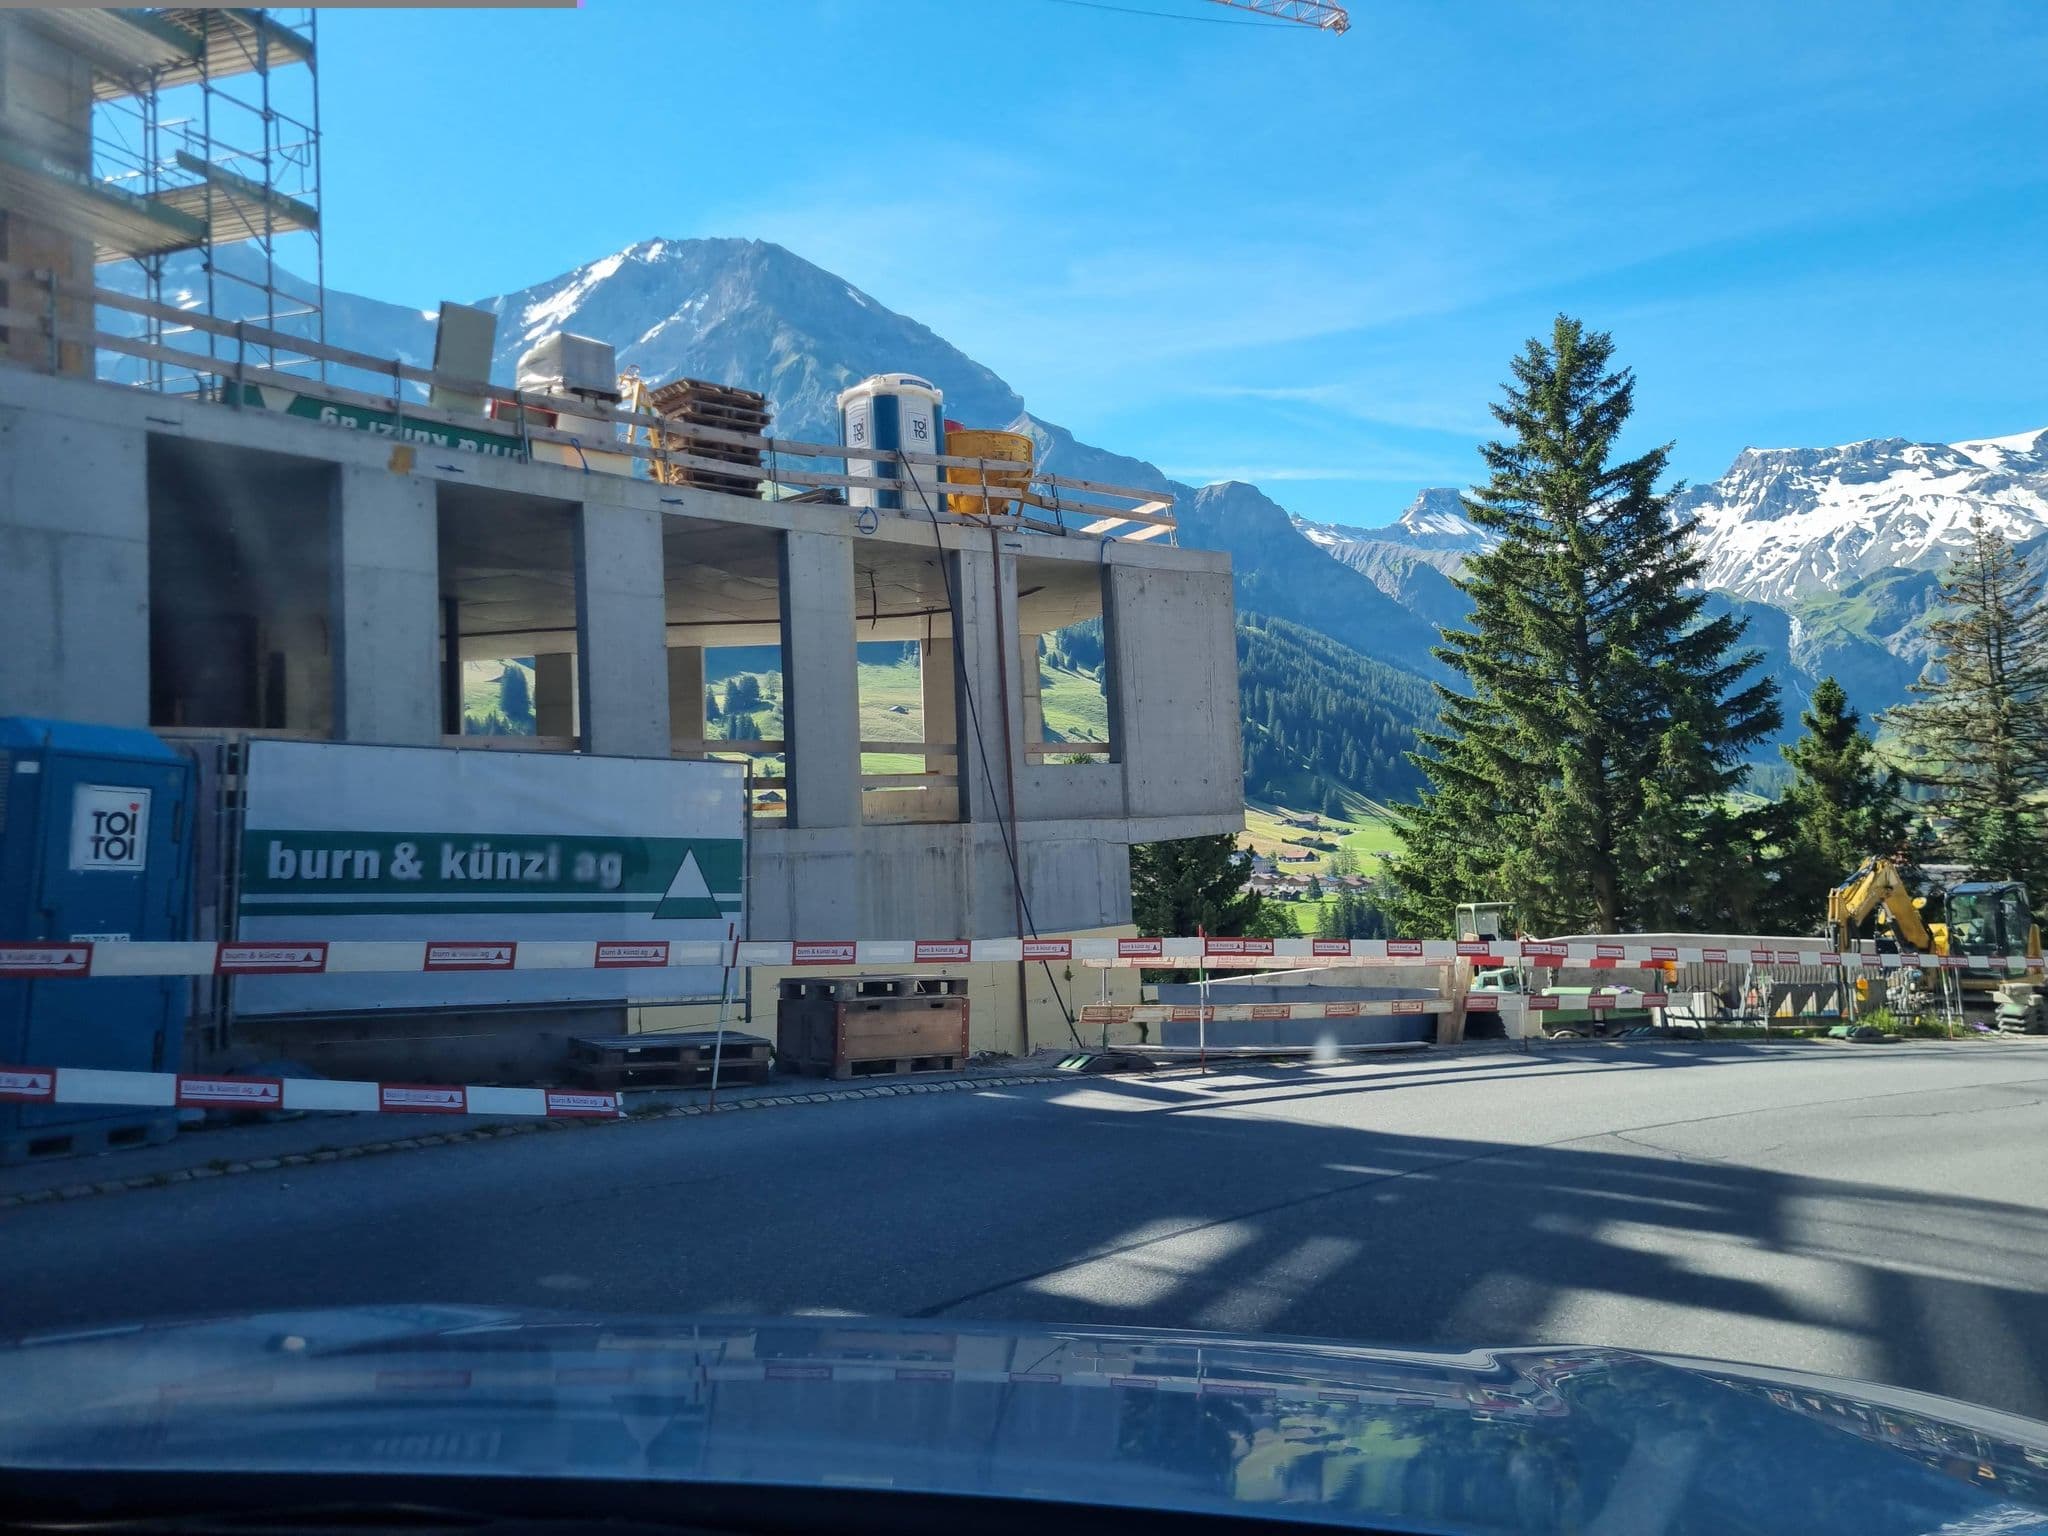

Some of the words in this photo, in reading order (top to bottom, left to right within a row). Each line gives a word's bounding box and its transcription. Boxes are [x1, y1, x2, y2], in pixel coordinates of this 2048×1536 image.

[91, 802, 140, 836] TOI
[90, 836, 135, 861] TOI
[268, 840, 381, 880] burn
[390, 842, 424, 880] &
[573, 851, 623, 889] ag
